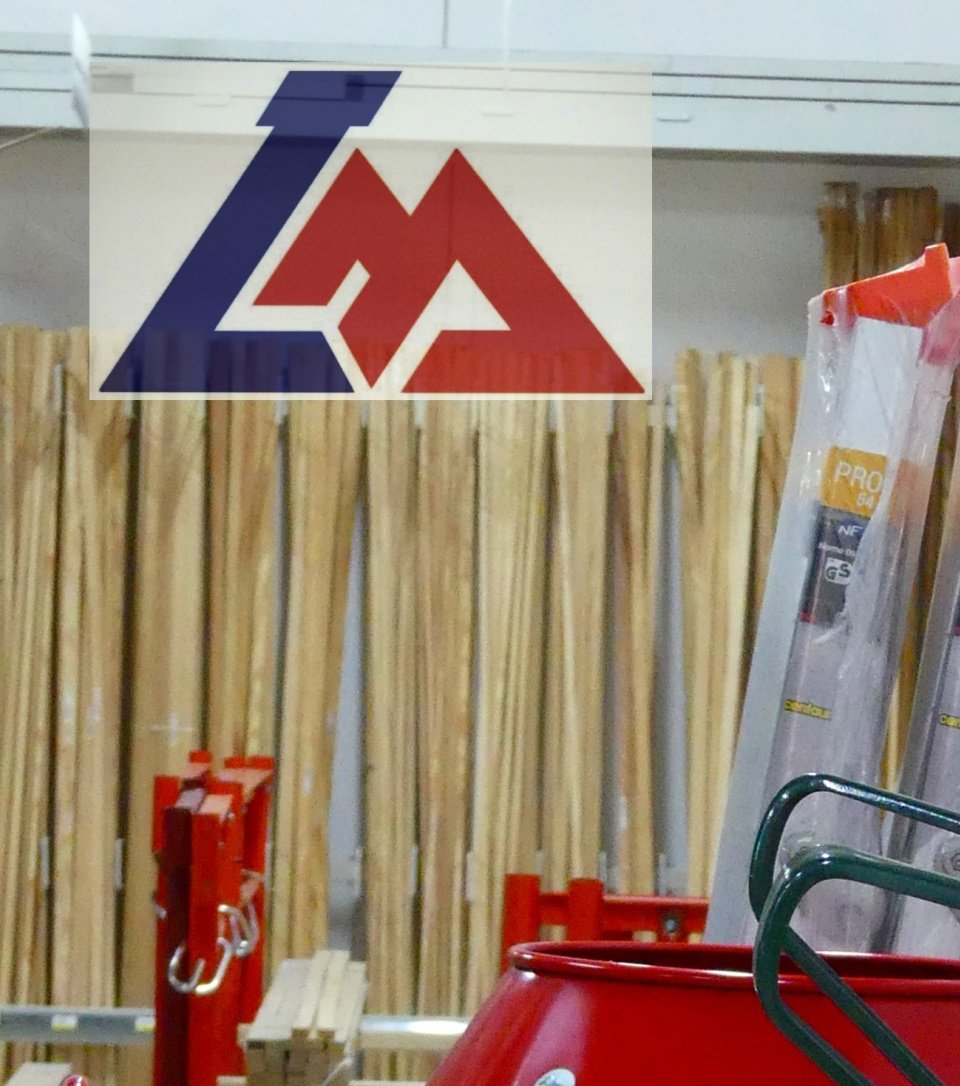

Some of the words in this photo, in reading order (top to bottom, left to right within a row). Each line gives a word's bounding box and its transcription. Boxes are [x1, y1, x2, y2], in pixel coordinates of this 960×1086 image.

[835, 461, 883, 493] PRO
[838, 524, 864, 537] NF
[825, 562, 852, 580] GS
